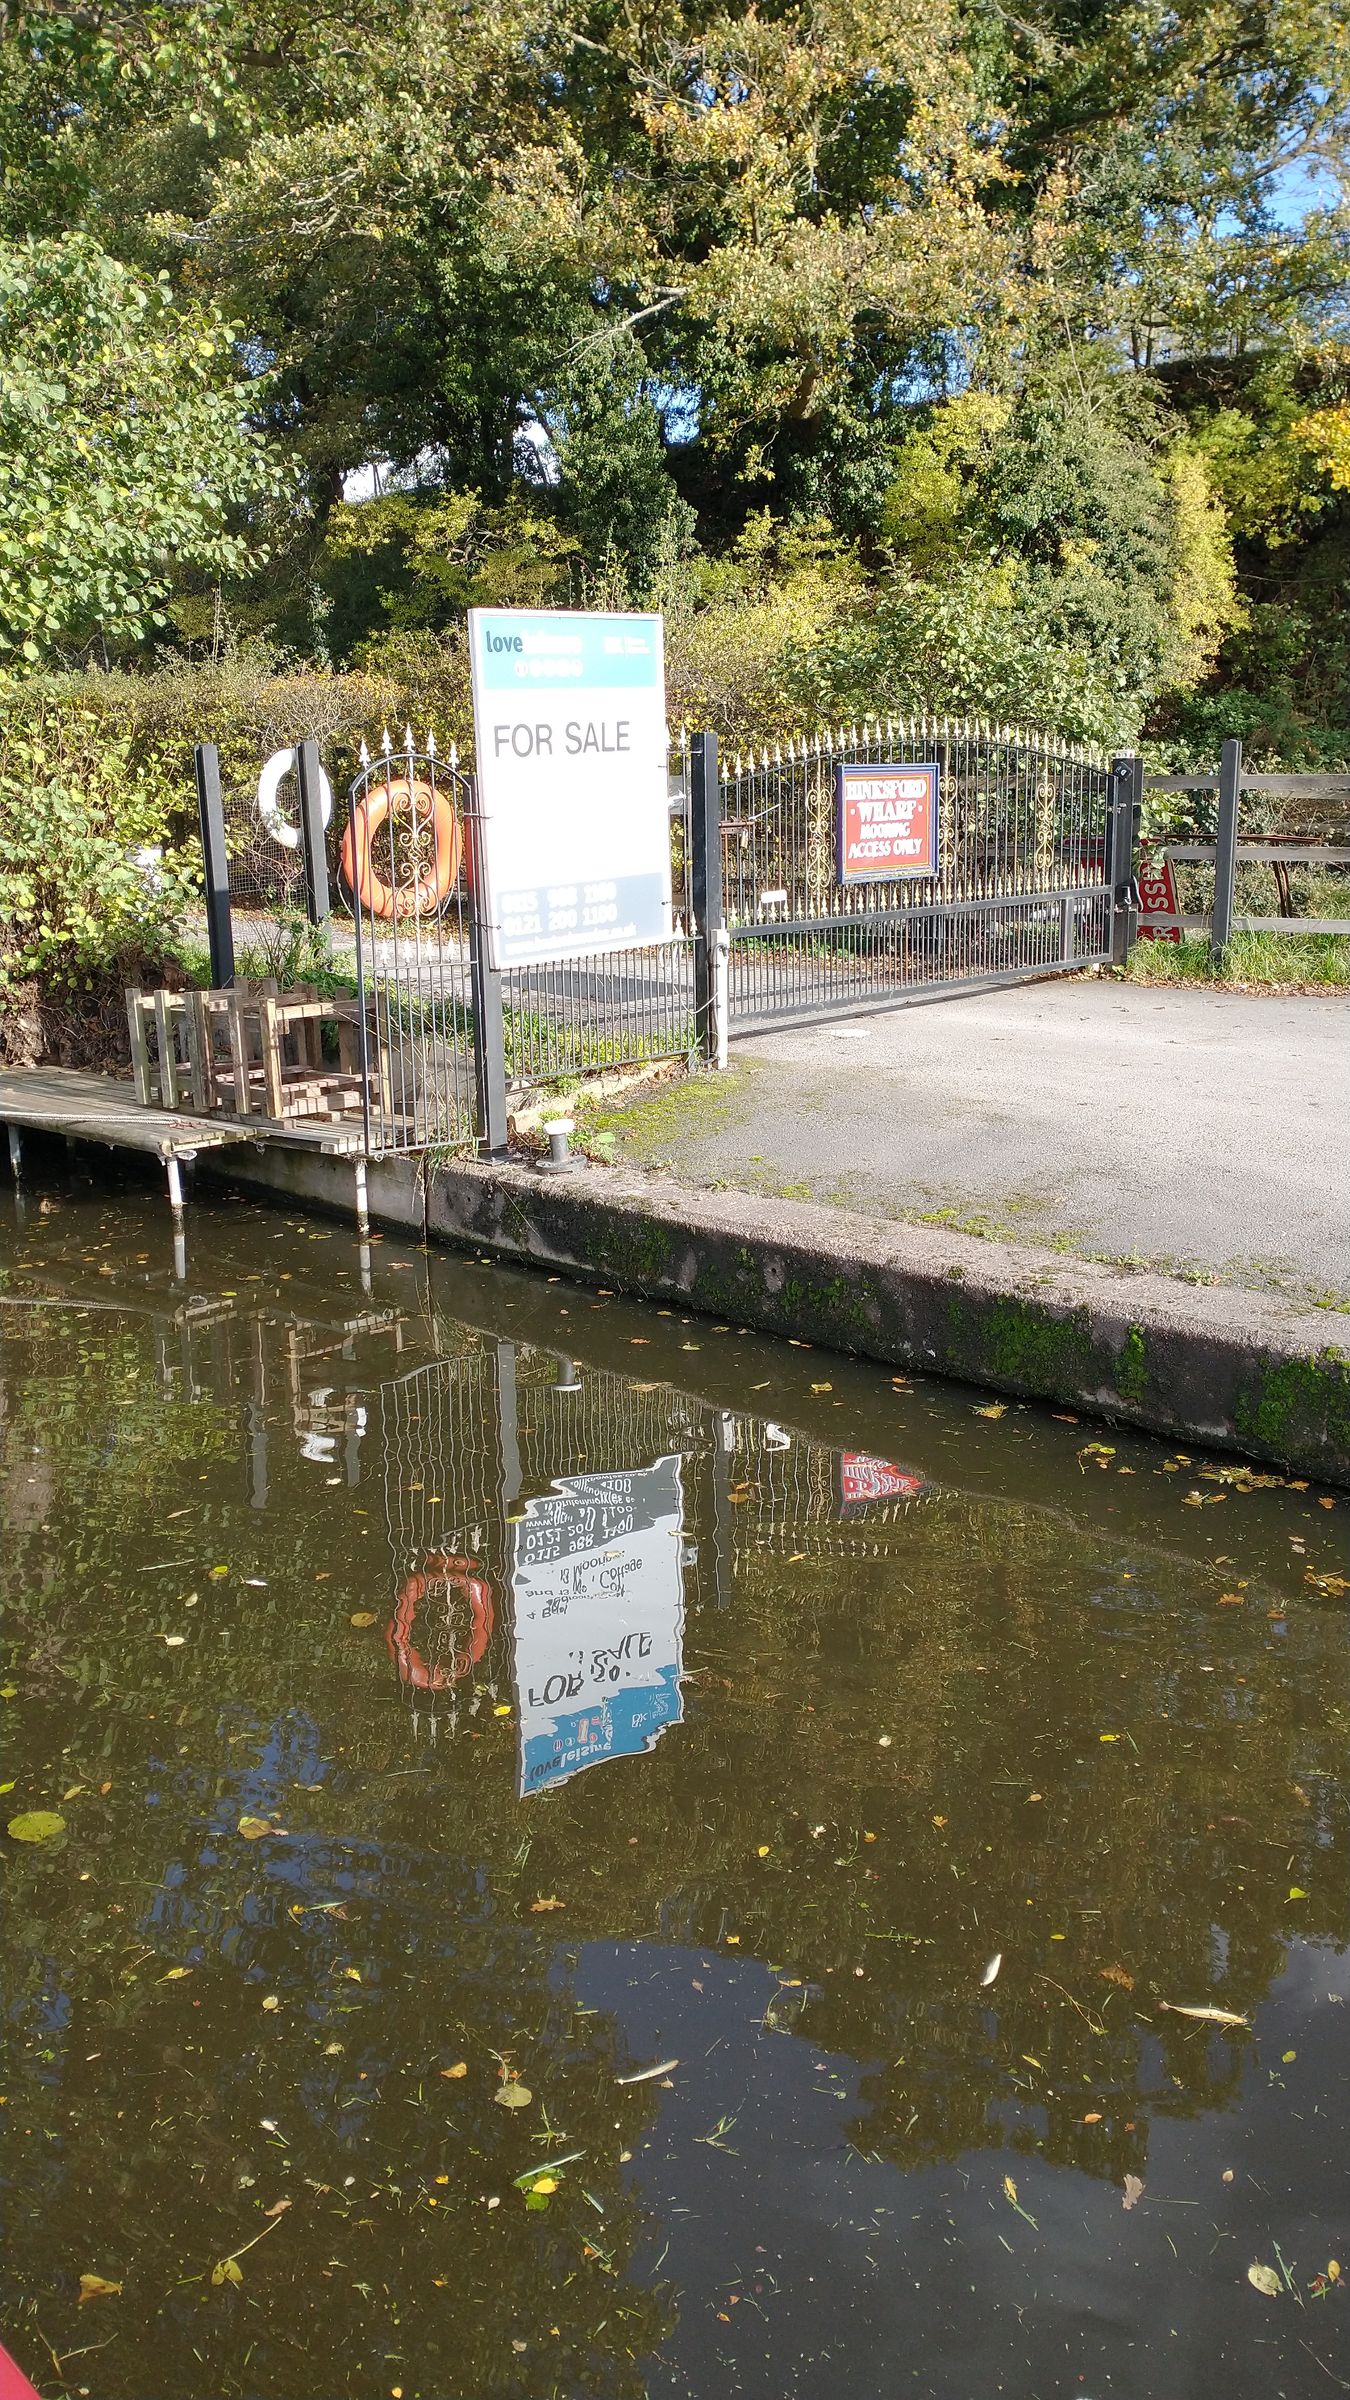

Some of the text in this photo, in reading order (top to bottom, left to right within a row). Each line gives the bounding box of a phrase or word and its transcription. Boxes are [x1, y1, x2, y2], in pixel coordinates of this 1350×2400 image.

[494, 721, 631, 758] FOR SALE
[846, 779, 927, 800] HINKSFORD
[857, 800, 917, 822] WHARF
[860, 822, 911, 840] MOORING
[848, 838, 923, 859] ACCESS ONLY
